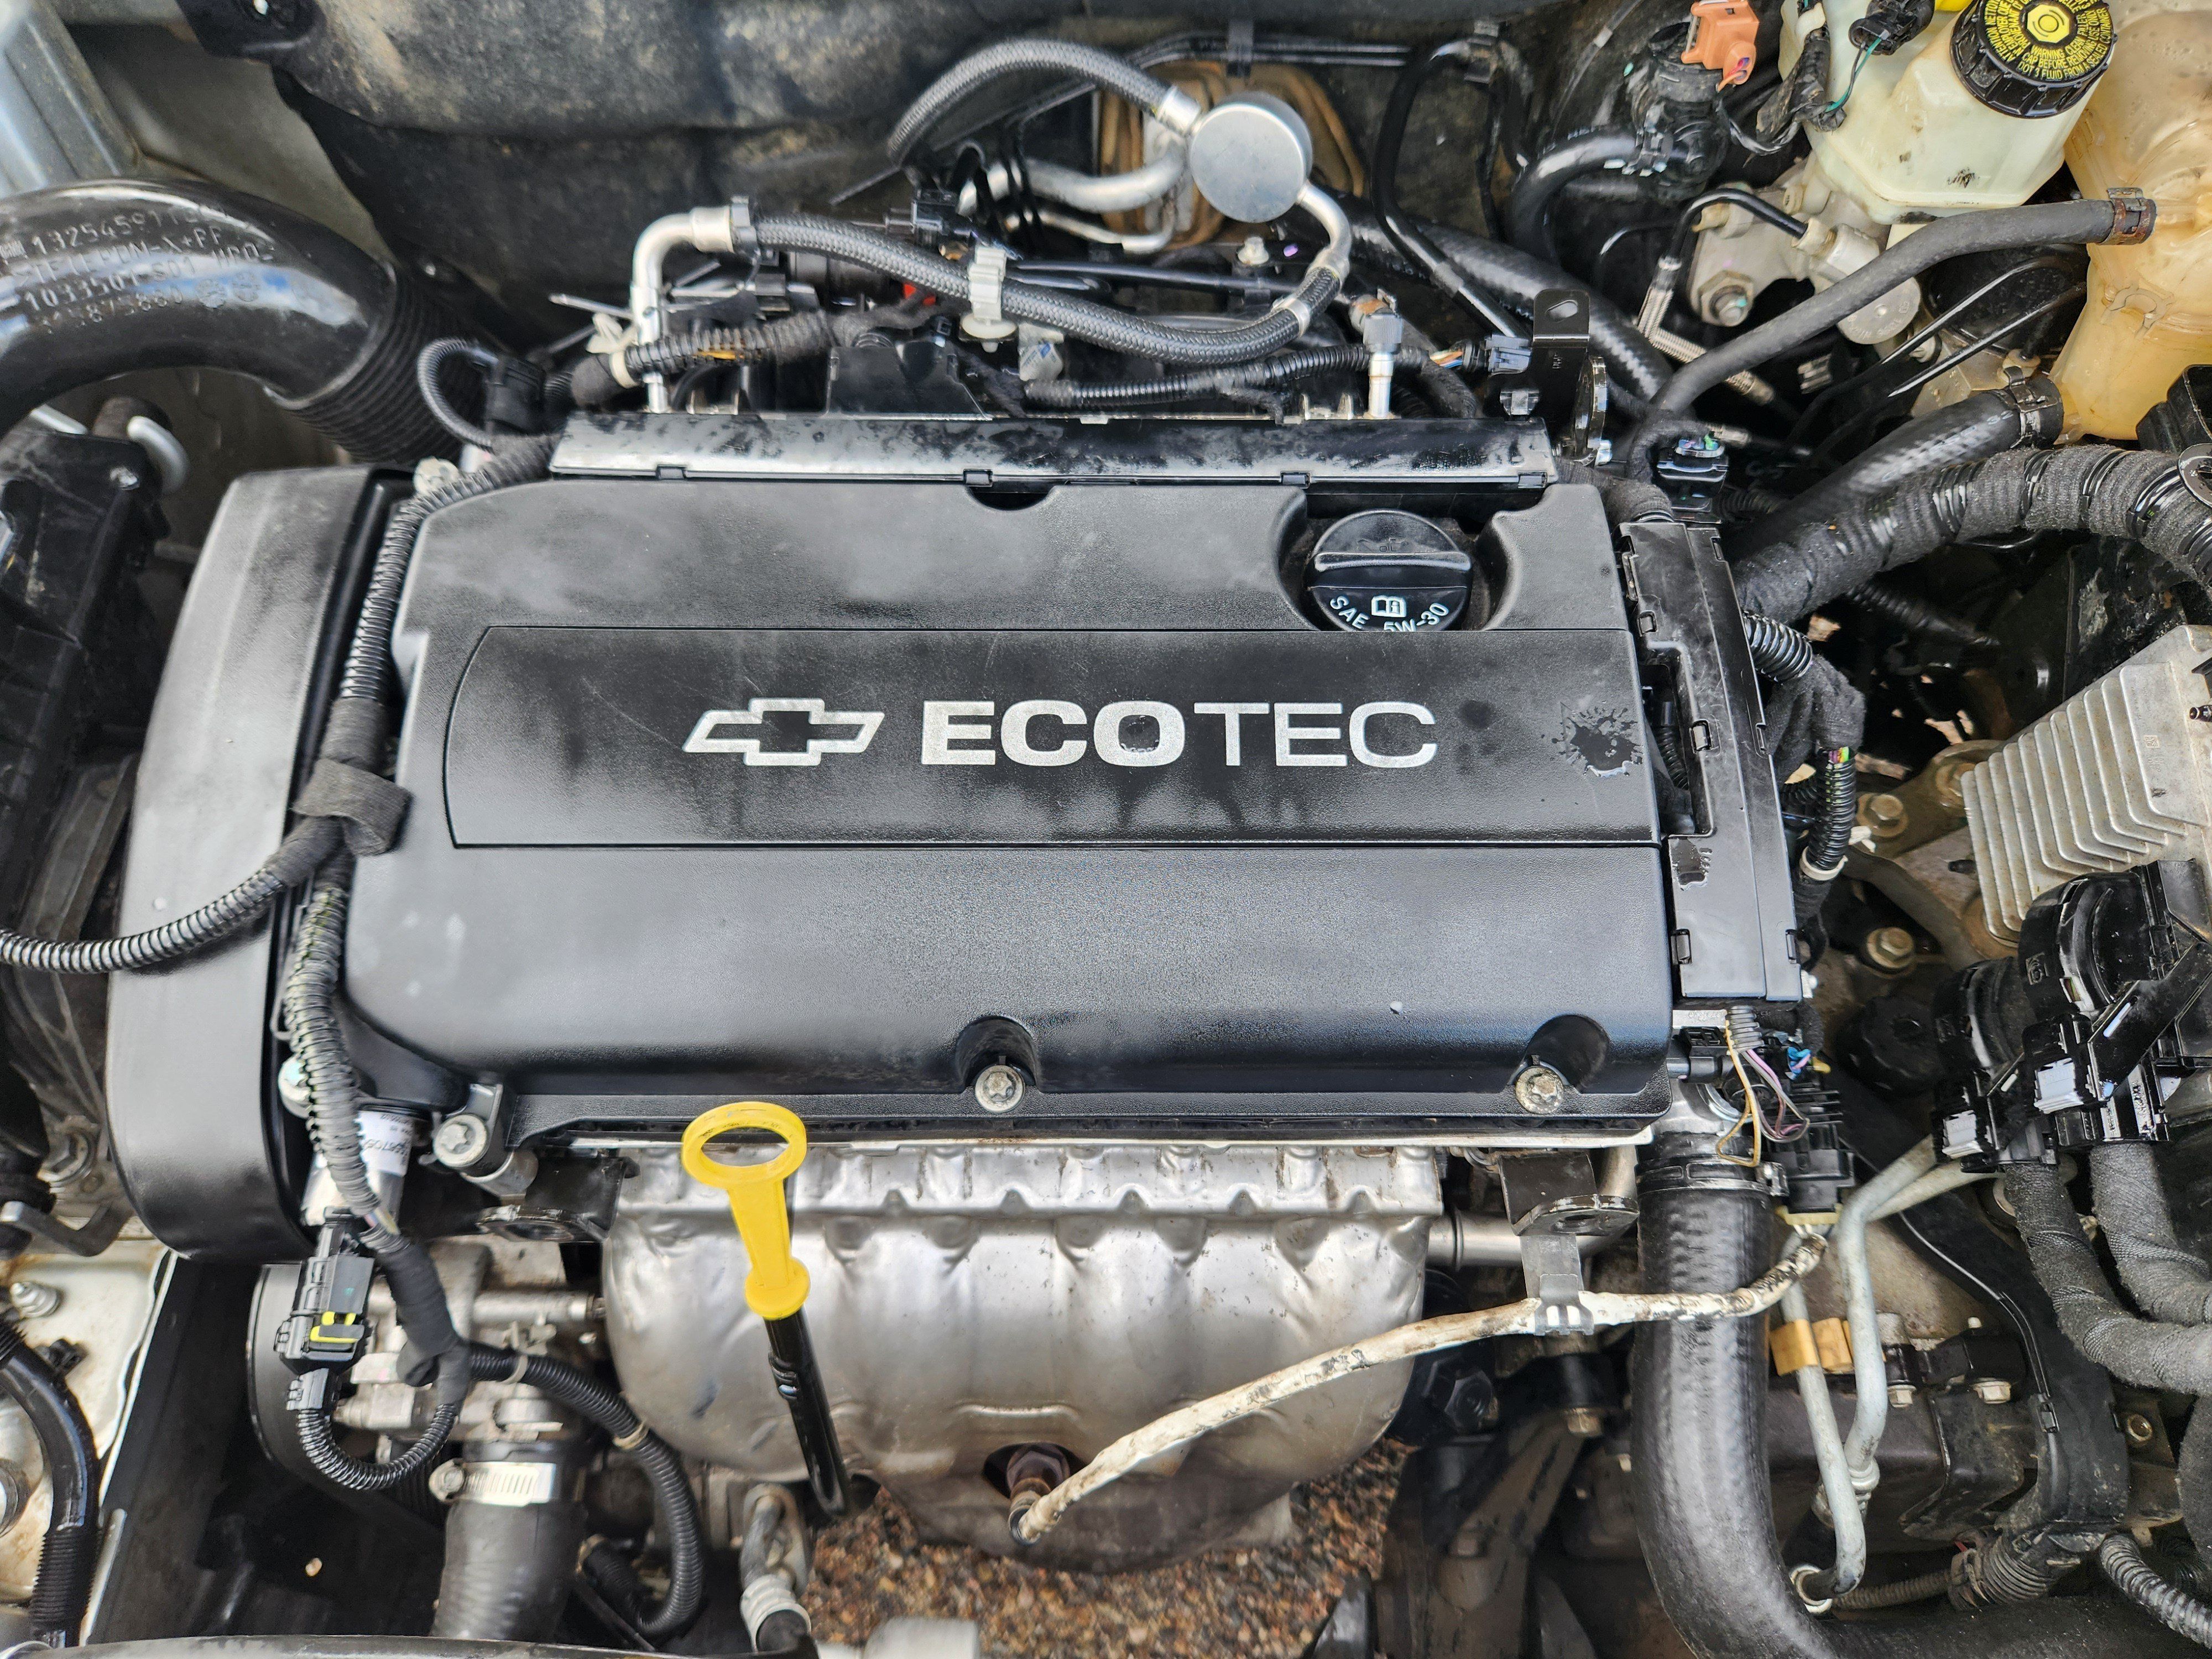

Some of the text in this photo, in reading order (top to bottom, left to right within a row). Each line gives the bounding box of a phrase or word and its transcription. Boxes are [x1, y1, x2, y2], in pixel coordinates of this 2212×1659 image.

[1985, 26, 2016, 62] ATTENTION
[2008, 9, 2031, 49] PROVENANT
[2016, 7, 2112, 81] DOT 3 FLUID FROM A SEALED CONTAINER
[2022, 9, 2100, 70] CAP BEFORE REMOVING USE ONLY
[2031, 13, 2088, 60] WARNING CLEAN FILLER
[1329, 596, 1449, 632] SAE 5W-30
[921, 700, 1437, 768] ECOTEC
